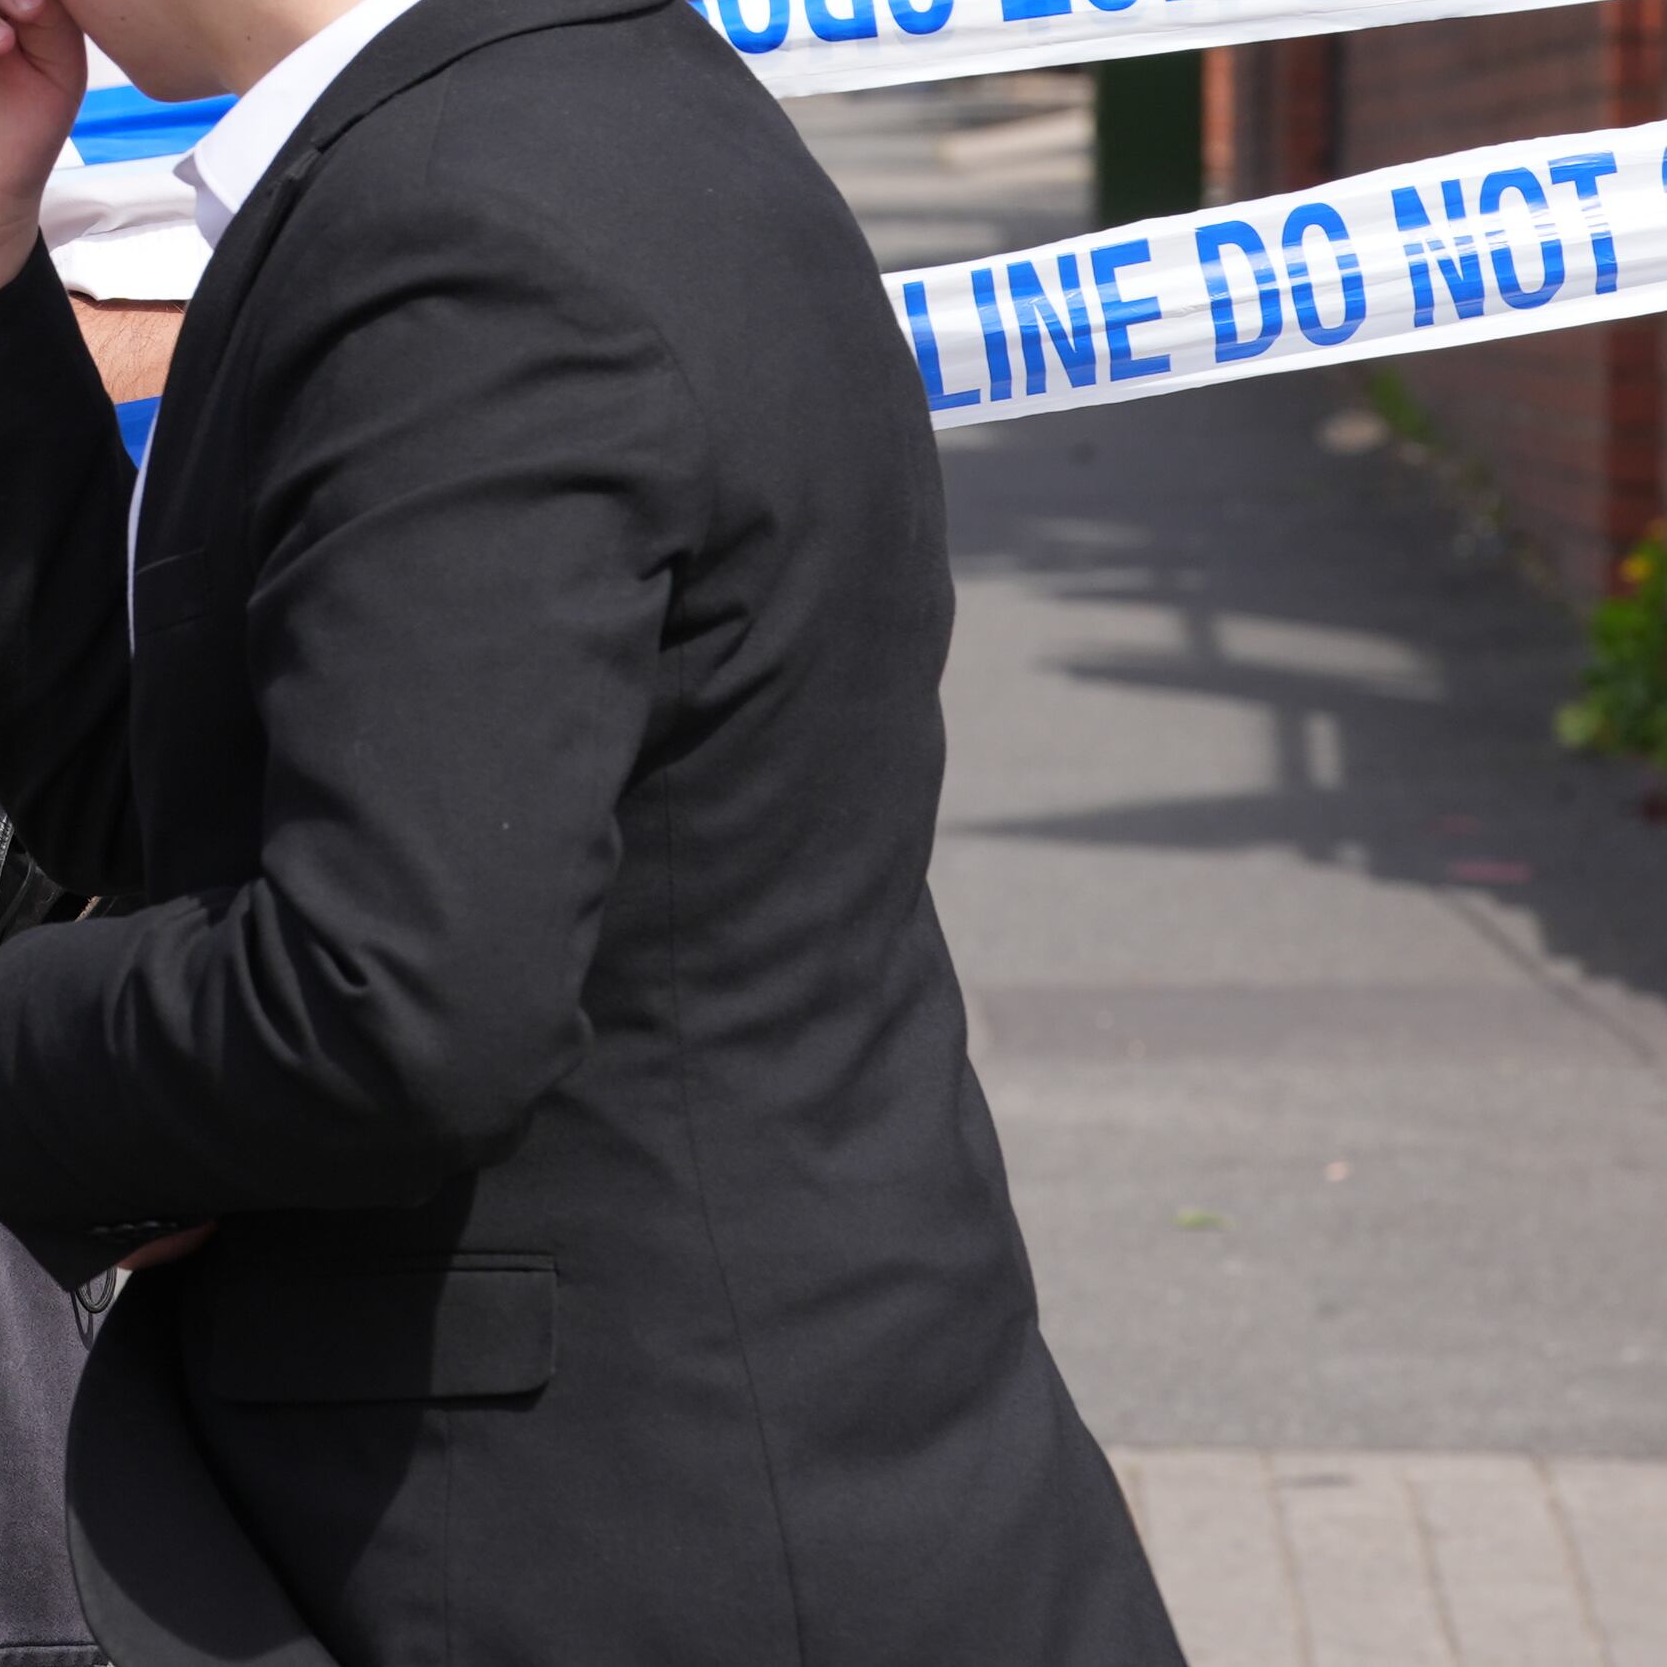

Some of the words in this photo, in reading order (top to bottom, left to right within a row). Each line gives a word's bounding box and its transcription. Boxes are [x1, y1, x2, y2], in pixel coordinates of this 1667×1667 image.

[902, 237, 1172, 413] LINE
[1195, 200, 1368, 364] DO
[1391, 150, 1618, 329] NOT
